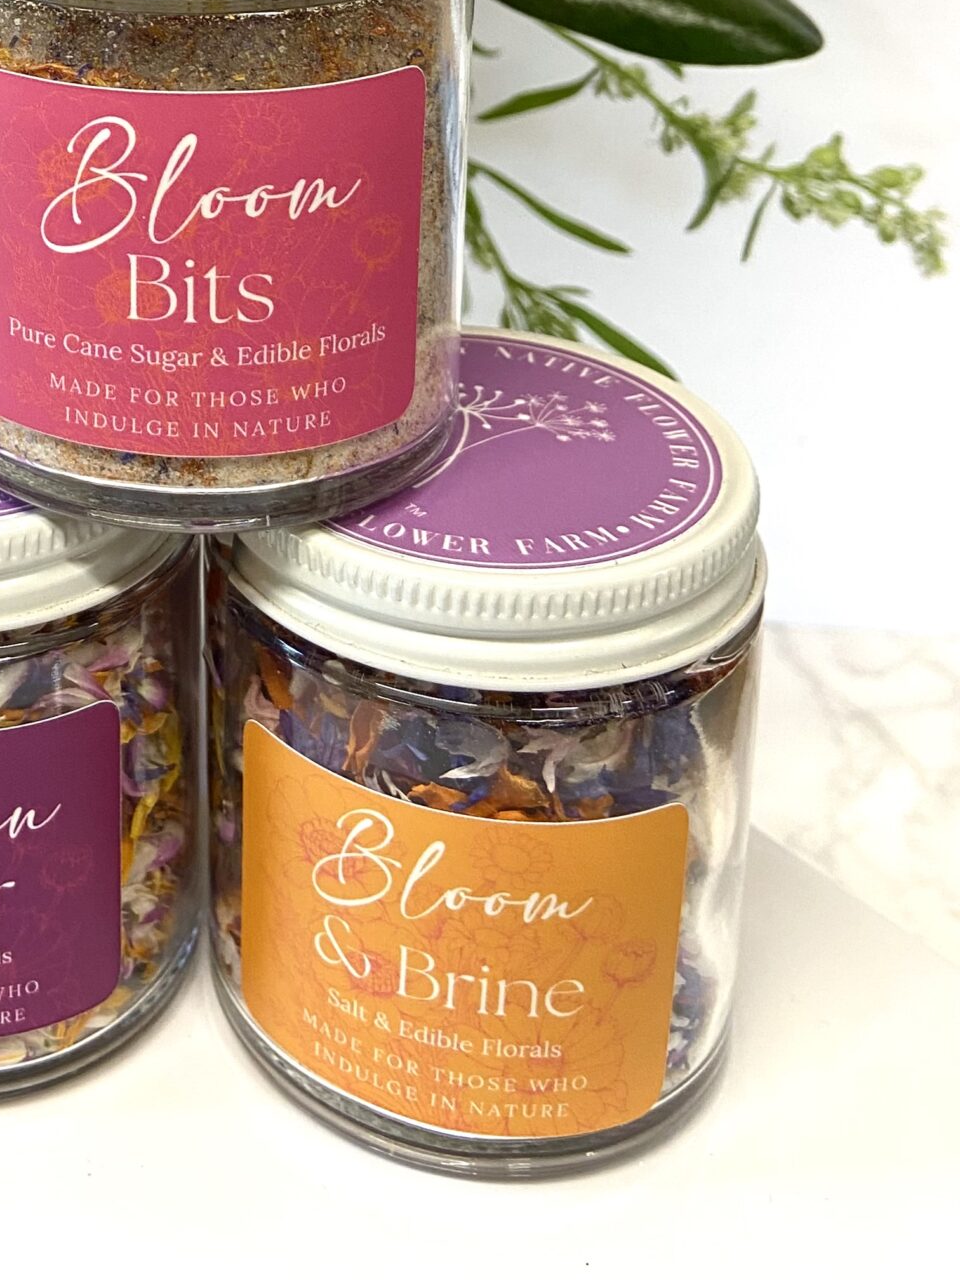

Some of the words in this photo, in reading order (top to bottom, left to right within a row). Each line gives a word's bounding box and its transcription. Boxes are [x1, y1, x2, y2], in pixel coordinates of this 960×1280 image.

[40, 116, 361, 253] Bloom
[127, 253, 274, 323] Bits
[8, 316, 56, 349] Pure
[63, 333, 122, 362] Cane
[131, 344, 202, 372] Sugar
[211, 348, 229, 367] &
[238, 338, 311, 366] Edible
[319, 323, 387, 356] Florals
[496, 346, 619, 387] NATIVE
[50, 372, 117, 401] MADE
[130, 388, 180, 408] FOR
[191, 389, 279, 408] THOSE
[290, 376, 347, 402] WHO
[64, 406, 180, 437] INDULGE
[193, 422, 220, 438] IN
[233, 411, 332, 438] NATURE
[624, 393, 699, 468] FLOWER
[356, 514, 491, 555] LOWER
[516, 527, 618, 555] FARM
[404, 503, 428, 517] TM
[630, 478, 696, 529] FARM
[312, 808, 594, 923] Bloom
[314, 914, 370, 979] &
[396, 944, 585, 1018] Brine
[302, 1008, 361, 1054] MADE
[373, 1048, 419, 1077] FOR
[431, 1065, 517, 1093] THOSE
[529, 1076, 589, 1093] WHO
[327, 988, 368, 1025] Salt
[373, 1011, 391, 1031] &
[398, 1020, 473, 1054] Edible
[482, 1038, 562, 1059] Florals
[314, 1041, 419, 1102] INDULGE
[431, 1092, 456, 1111] IN
[469, 1100, 569, 1119] NATURE
